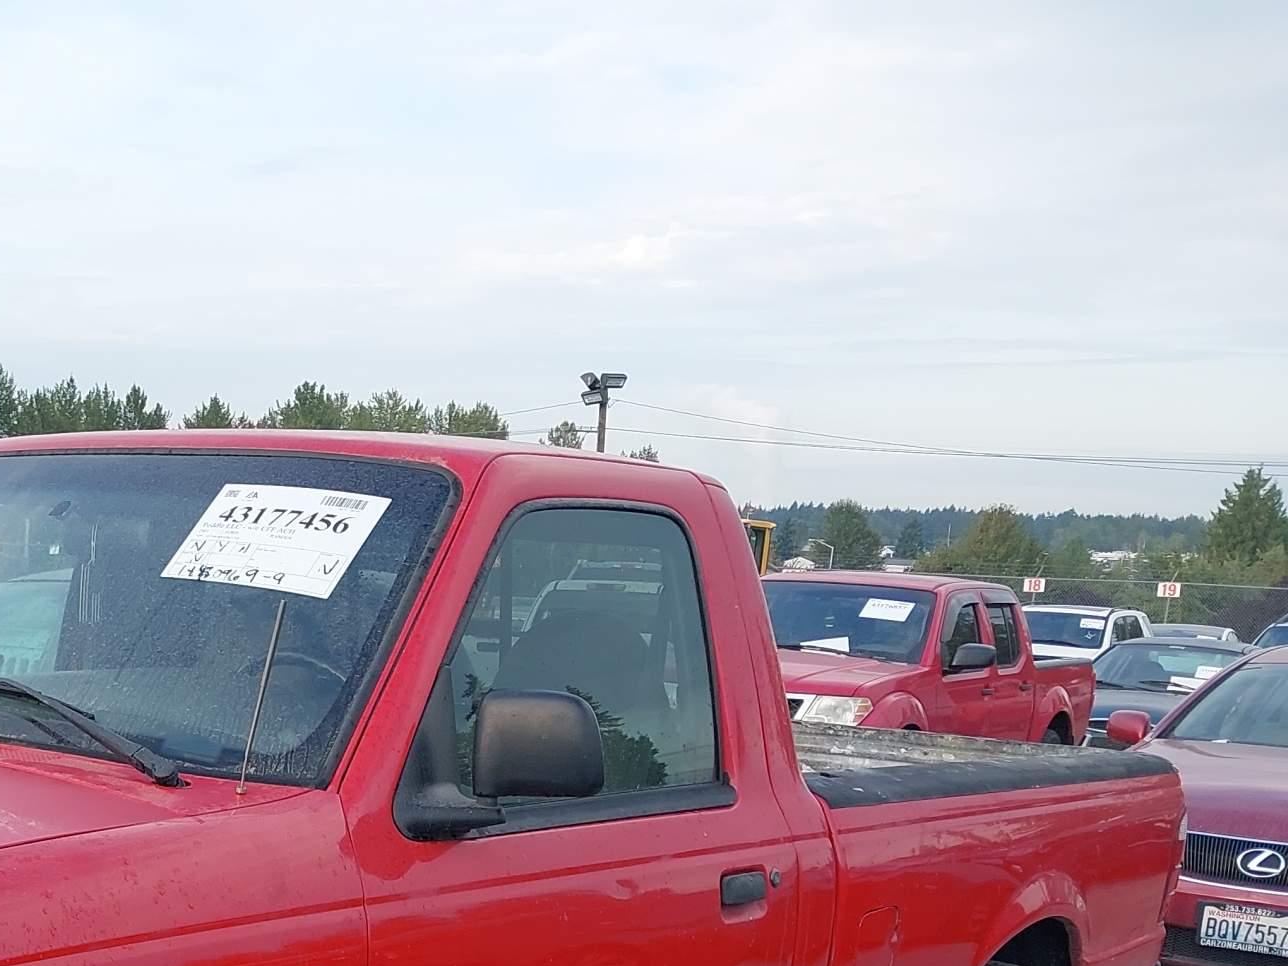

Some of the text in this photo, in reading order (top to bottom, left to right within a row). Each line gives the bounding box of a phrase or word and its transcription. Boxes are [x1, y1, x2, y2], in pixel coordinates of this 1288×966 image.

[219, 505, 356, 534] 43177456
[1027, 579, 1041, 592] 18
[1162, 583, 1177, 597] 19
[1208, 909, 1261, 922] WASHINGTON
